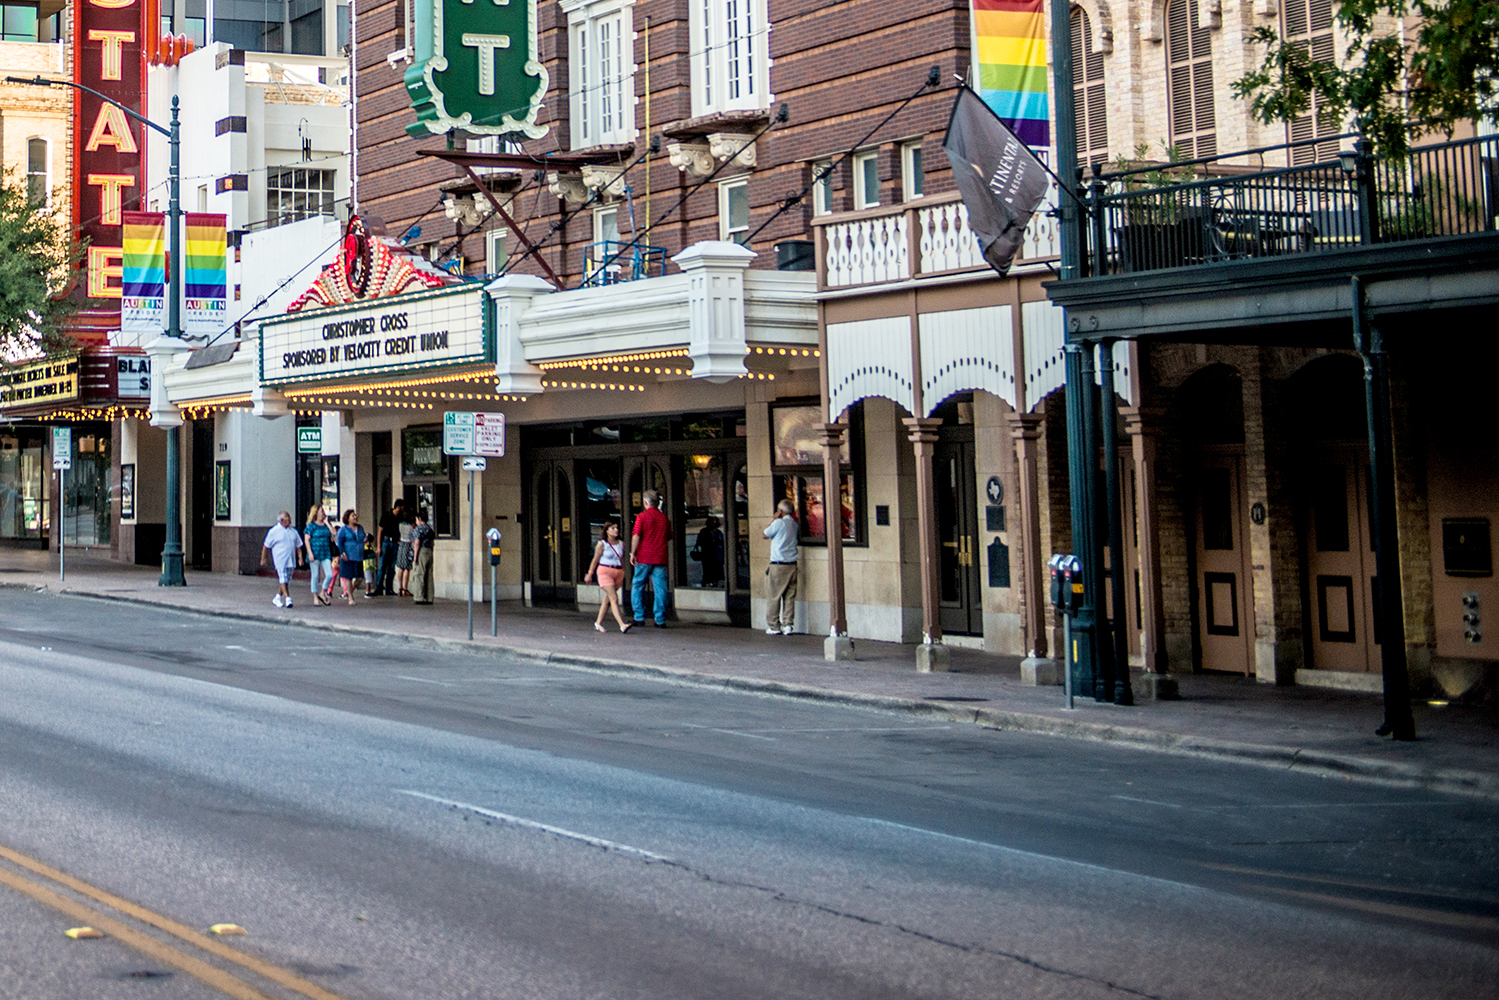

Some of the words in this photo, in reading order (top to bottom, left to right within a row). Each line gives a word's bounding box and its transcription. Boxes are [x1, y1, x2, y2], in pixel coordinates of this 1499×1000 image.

[1008, 160, 1027, 196] RESORTS
[123, 299, 163, 309] AUSTIN
[186, 300, 226, 310] AUSTIN
[322, 317, 376, 340] CHRISTOPHER
[380, 312, 409, 332] CROSS
[282, 348, 327, 369] SPONSORED
[330, 345, 339, 362] BY
[343, 339, 382, 362] VELOCITY
[385, 335, 417, 356] CREDIT
[420, 330, 449, 351] UNION
[53, 363, 65, 377] SALE
[300, 432, 320, 440] ATM
